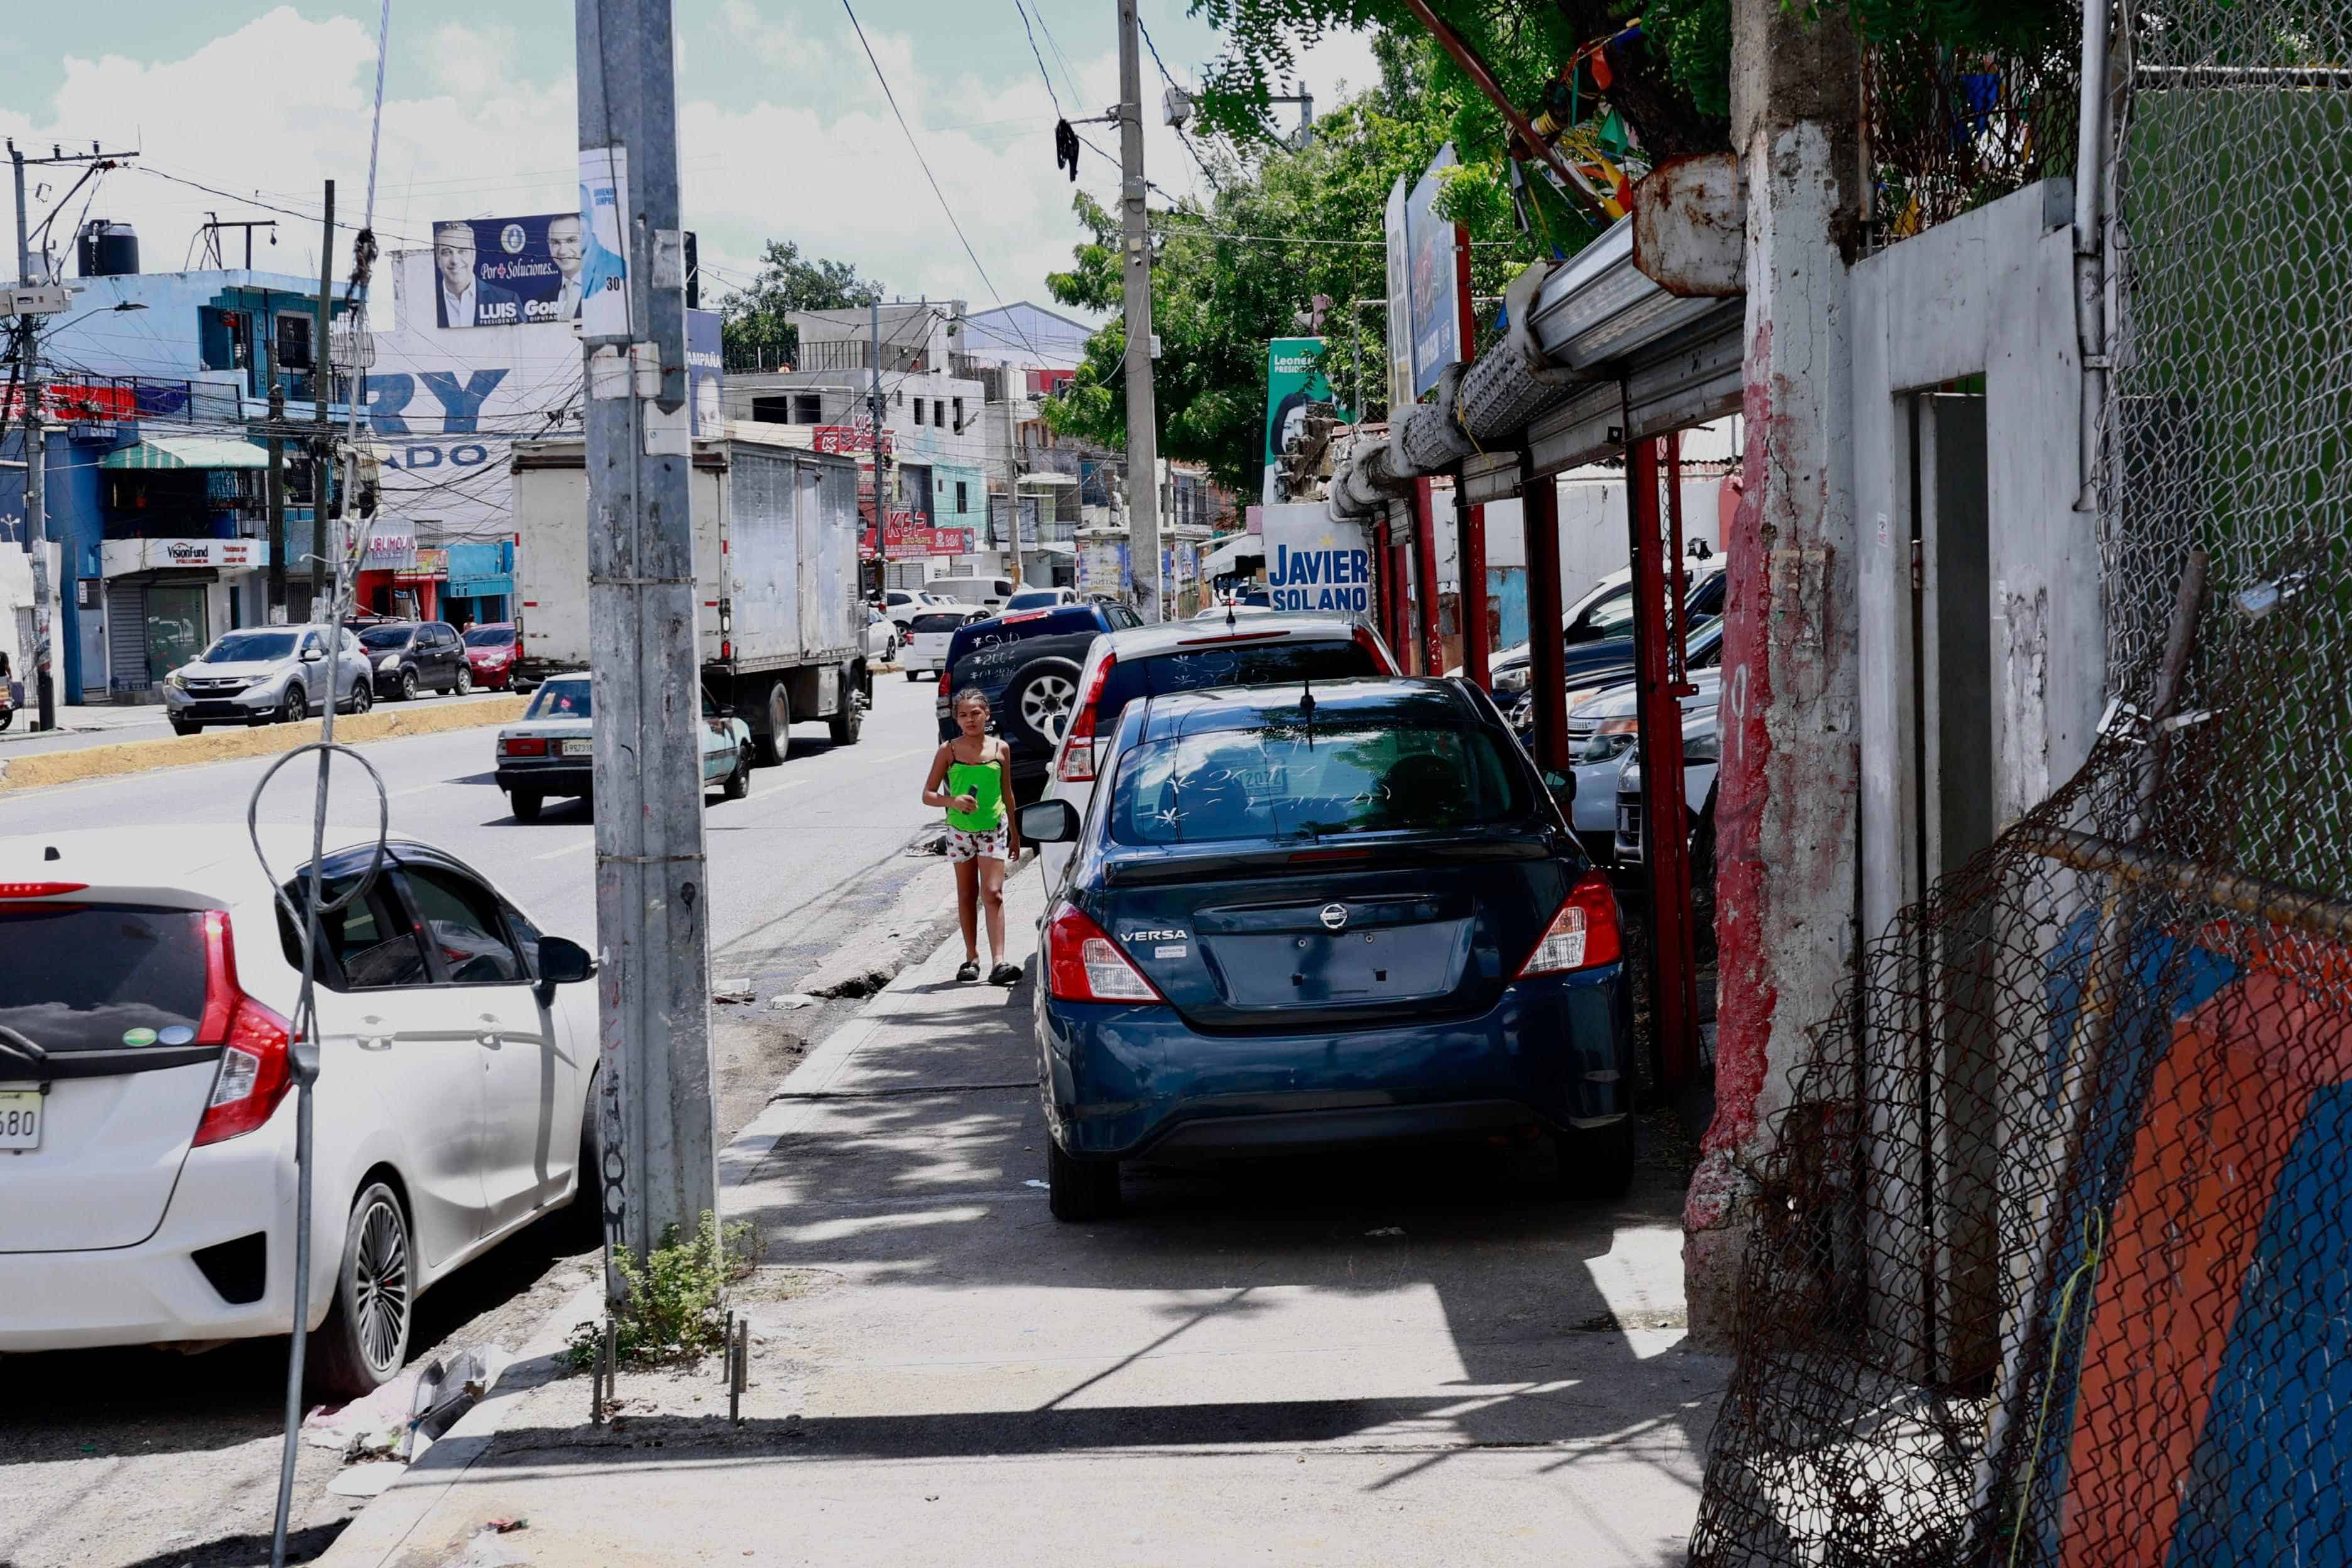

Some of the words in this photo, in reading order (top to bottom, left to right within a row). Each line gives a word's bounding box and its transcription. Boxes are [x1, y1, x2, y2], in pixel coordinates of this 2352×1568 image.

[481, 263, 498, 280] Por
[606, 276, 620, 291] 30
[479, 302, 517, 318] LUIS
[687, 351, 722, 368] AMPAÑA
[1269, 544, 1368, 587] JAVIER
[1273, 587, 1367, 611] SOLANO
[1120, 930, 1188, 942] VERSA
